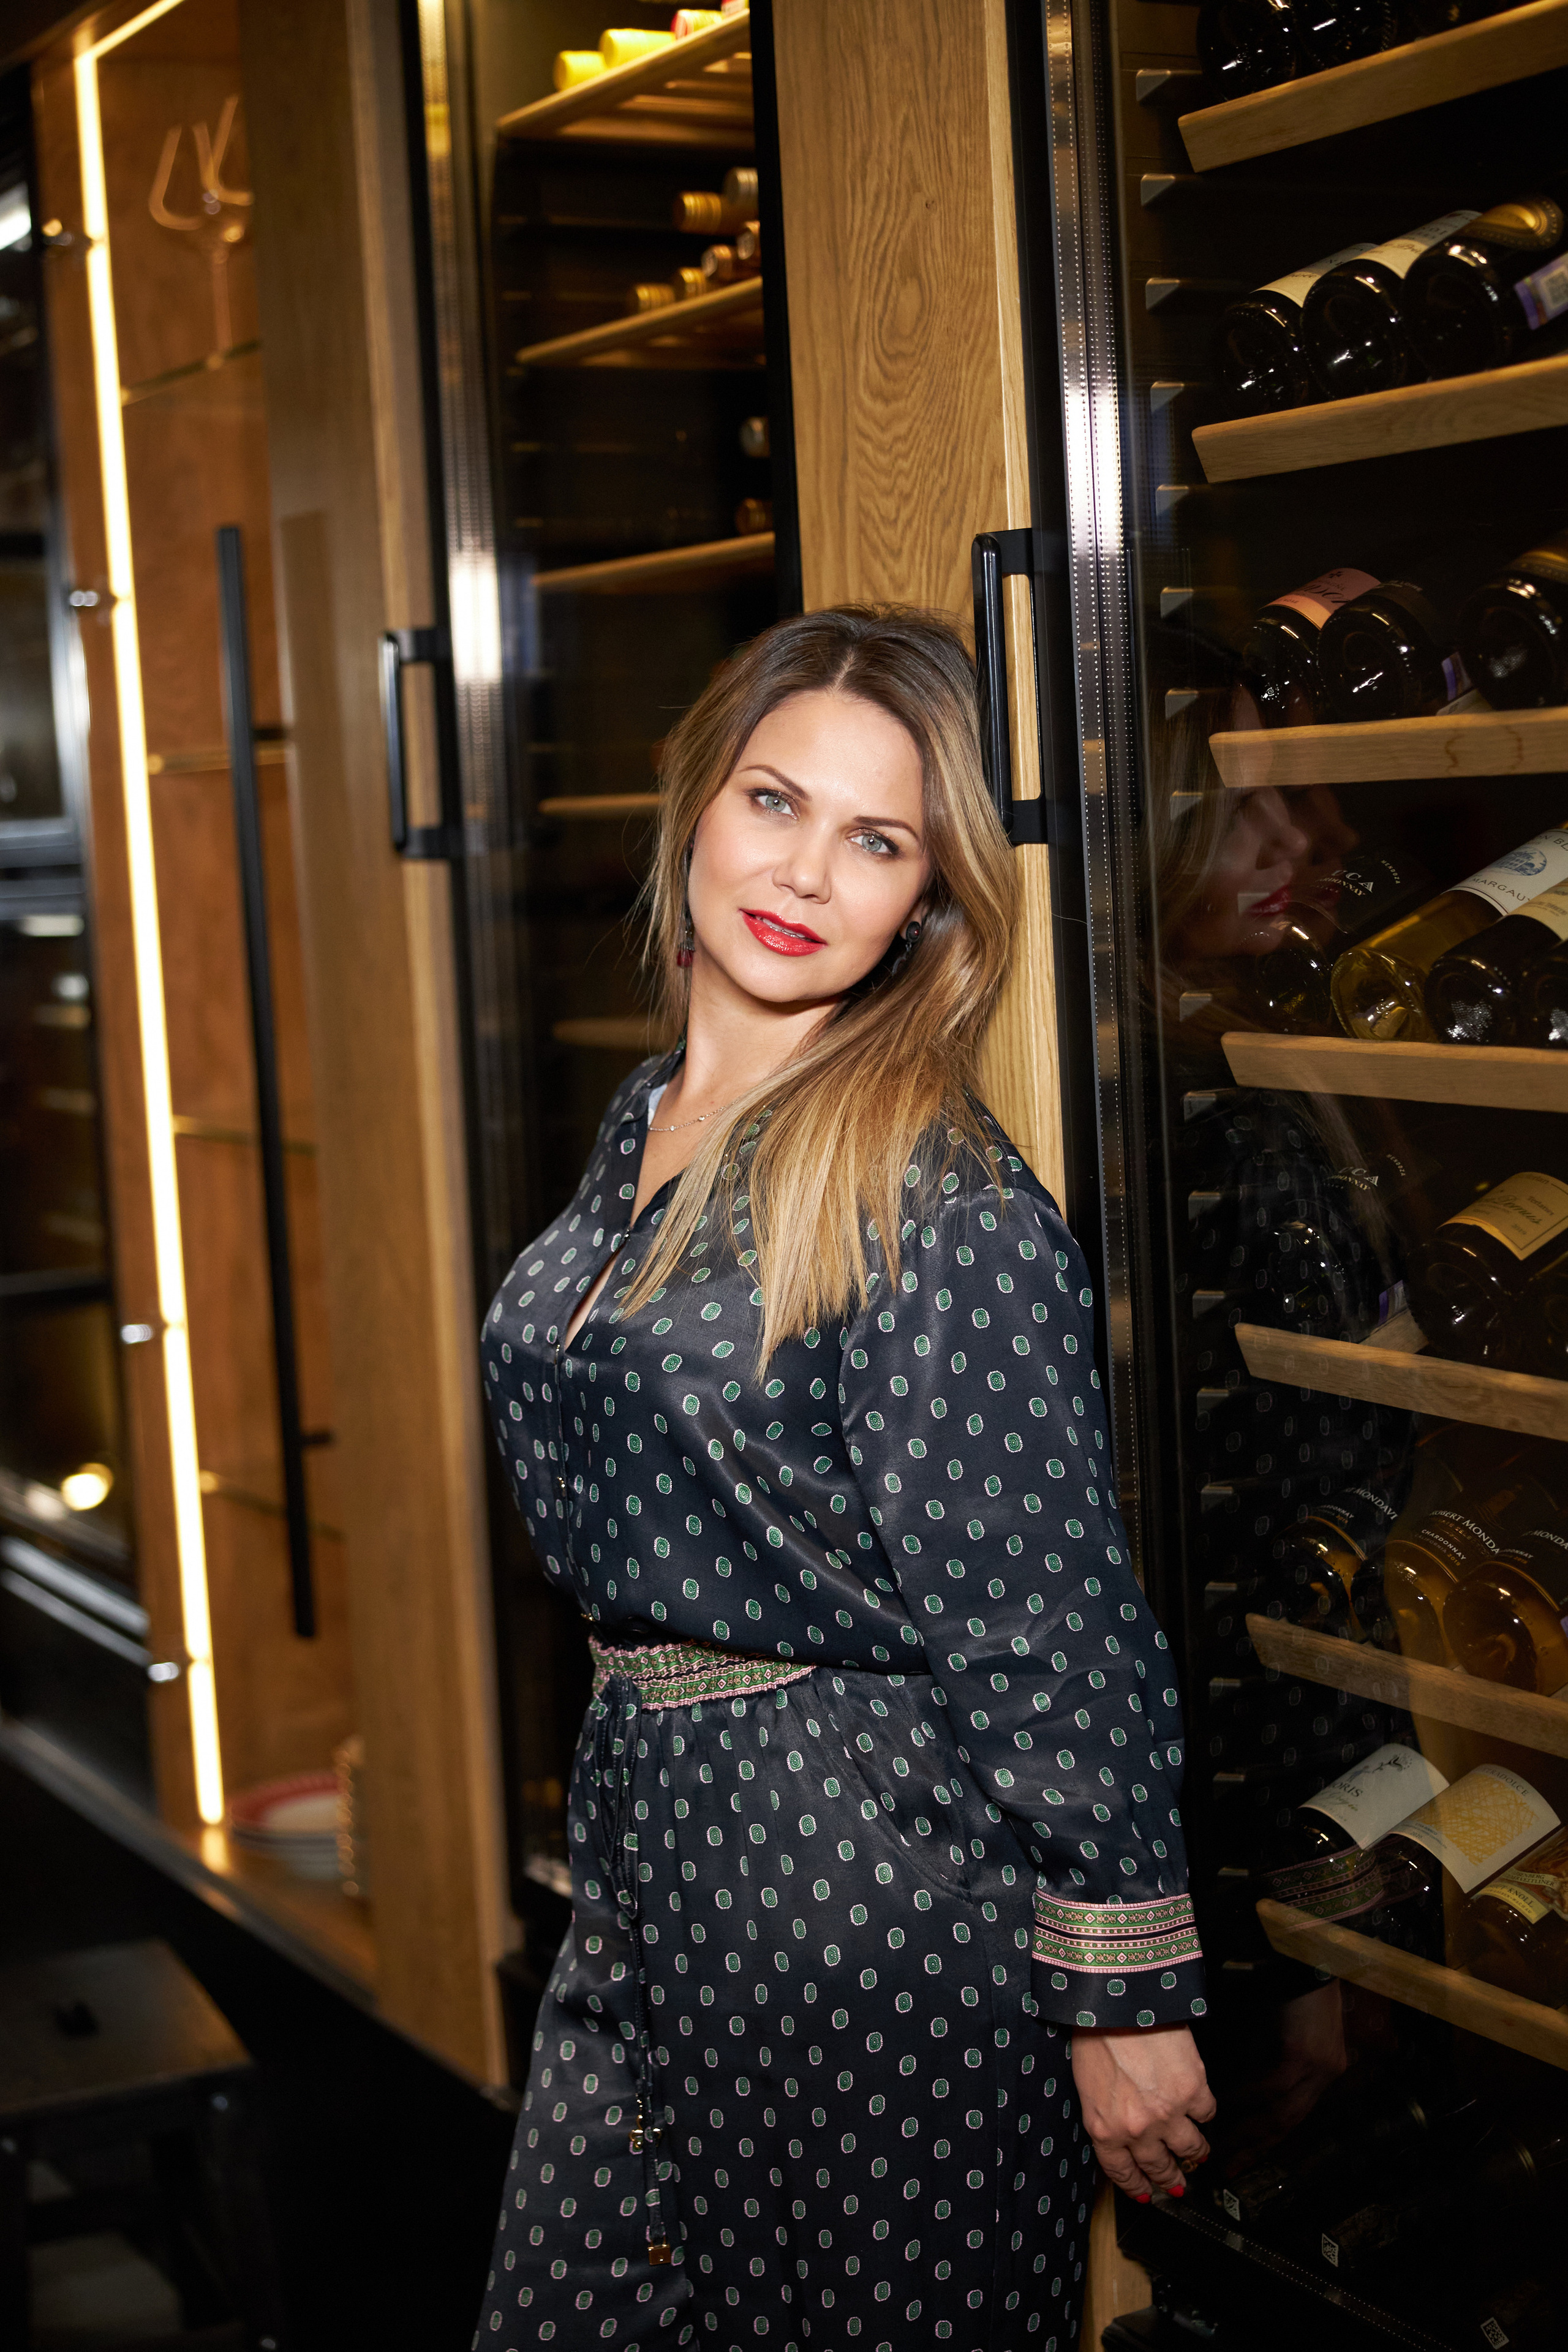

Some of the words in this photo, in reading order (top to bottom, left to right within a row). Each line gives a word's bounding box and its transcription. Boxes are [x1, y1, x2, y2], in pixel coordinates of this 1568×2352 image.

[1330, 869, 1374, 894] UCA
[1380, 859, 1401, 884] MENDOZA
[1316, 877, 1366, 896] ARDONNAY
[1385, 1153, 1406, 1177] MENDOZA
[1338, 1166, 1379, 1188] UCA
[1353, 1487, 1399, 1521] MONDAVI
[1415, 1534, 1447, 1554] CALIFORNIA
[1421, 1529, 1466, 1560] CHARDONNAY
[1461, 1519, 1500, 1555] MONDA
[1531, 1530, 1568, 1550] MONDA
[1332, 1781, 1363, 1798] ORIS
[1507, 1887, 1534, 1908] KNOLL
